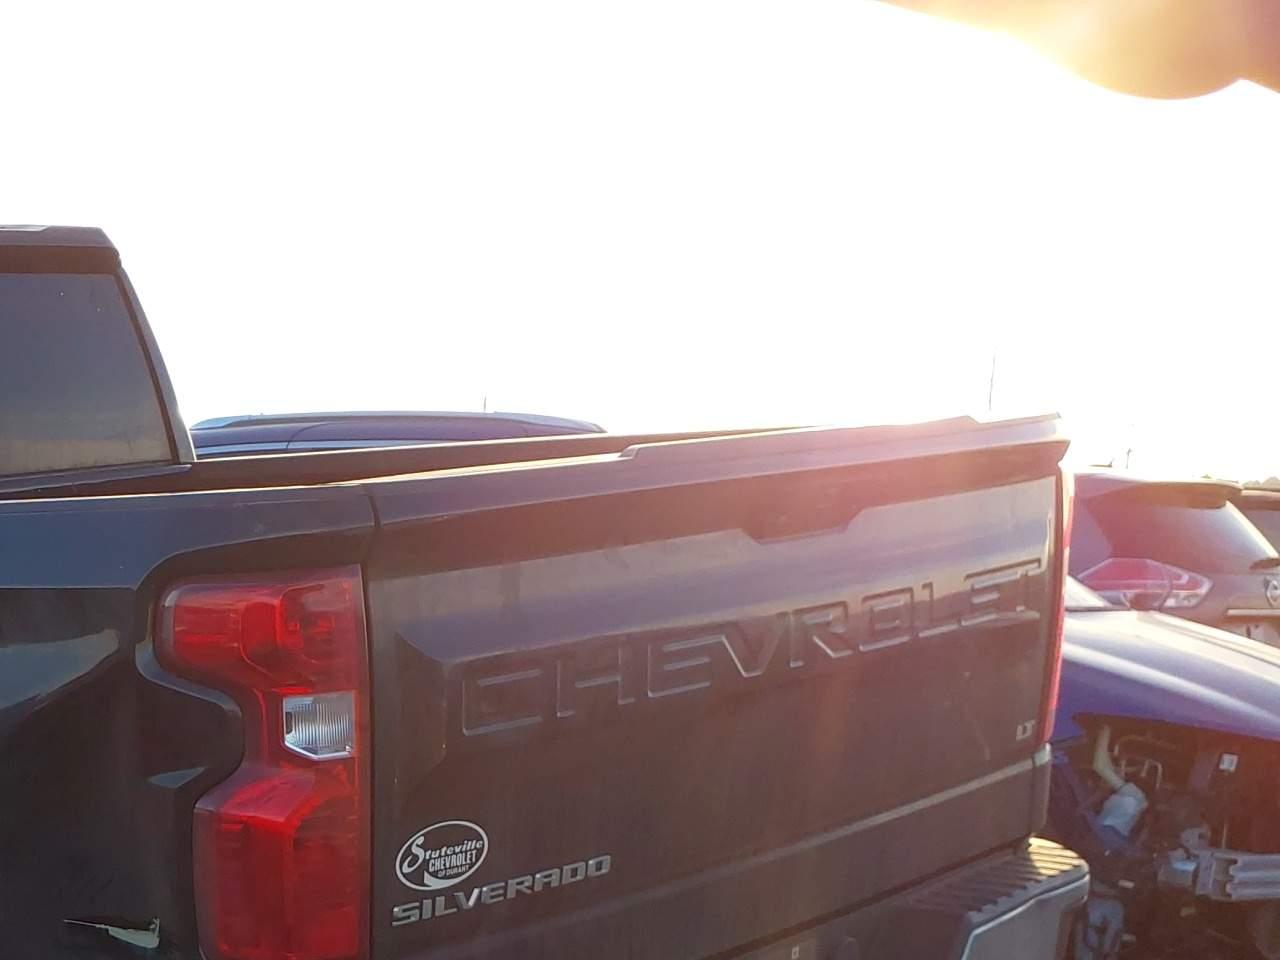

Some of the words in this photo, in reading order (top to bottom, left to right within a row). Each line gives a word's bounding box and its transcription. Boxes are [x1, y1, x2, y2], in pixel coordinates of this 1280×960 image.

[462, 557, 1041, 736] CHEVROLET
[402, 835, 484, 873] Stuteville
[428, 850, 477, 872] CHEVROLET
[446, 864, 470, 877] DURANT
[392, 855, 612, 927] SILVERADO
